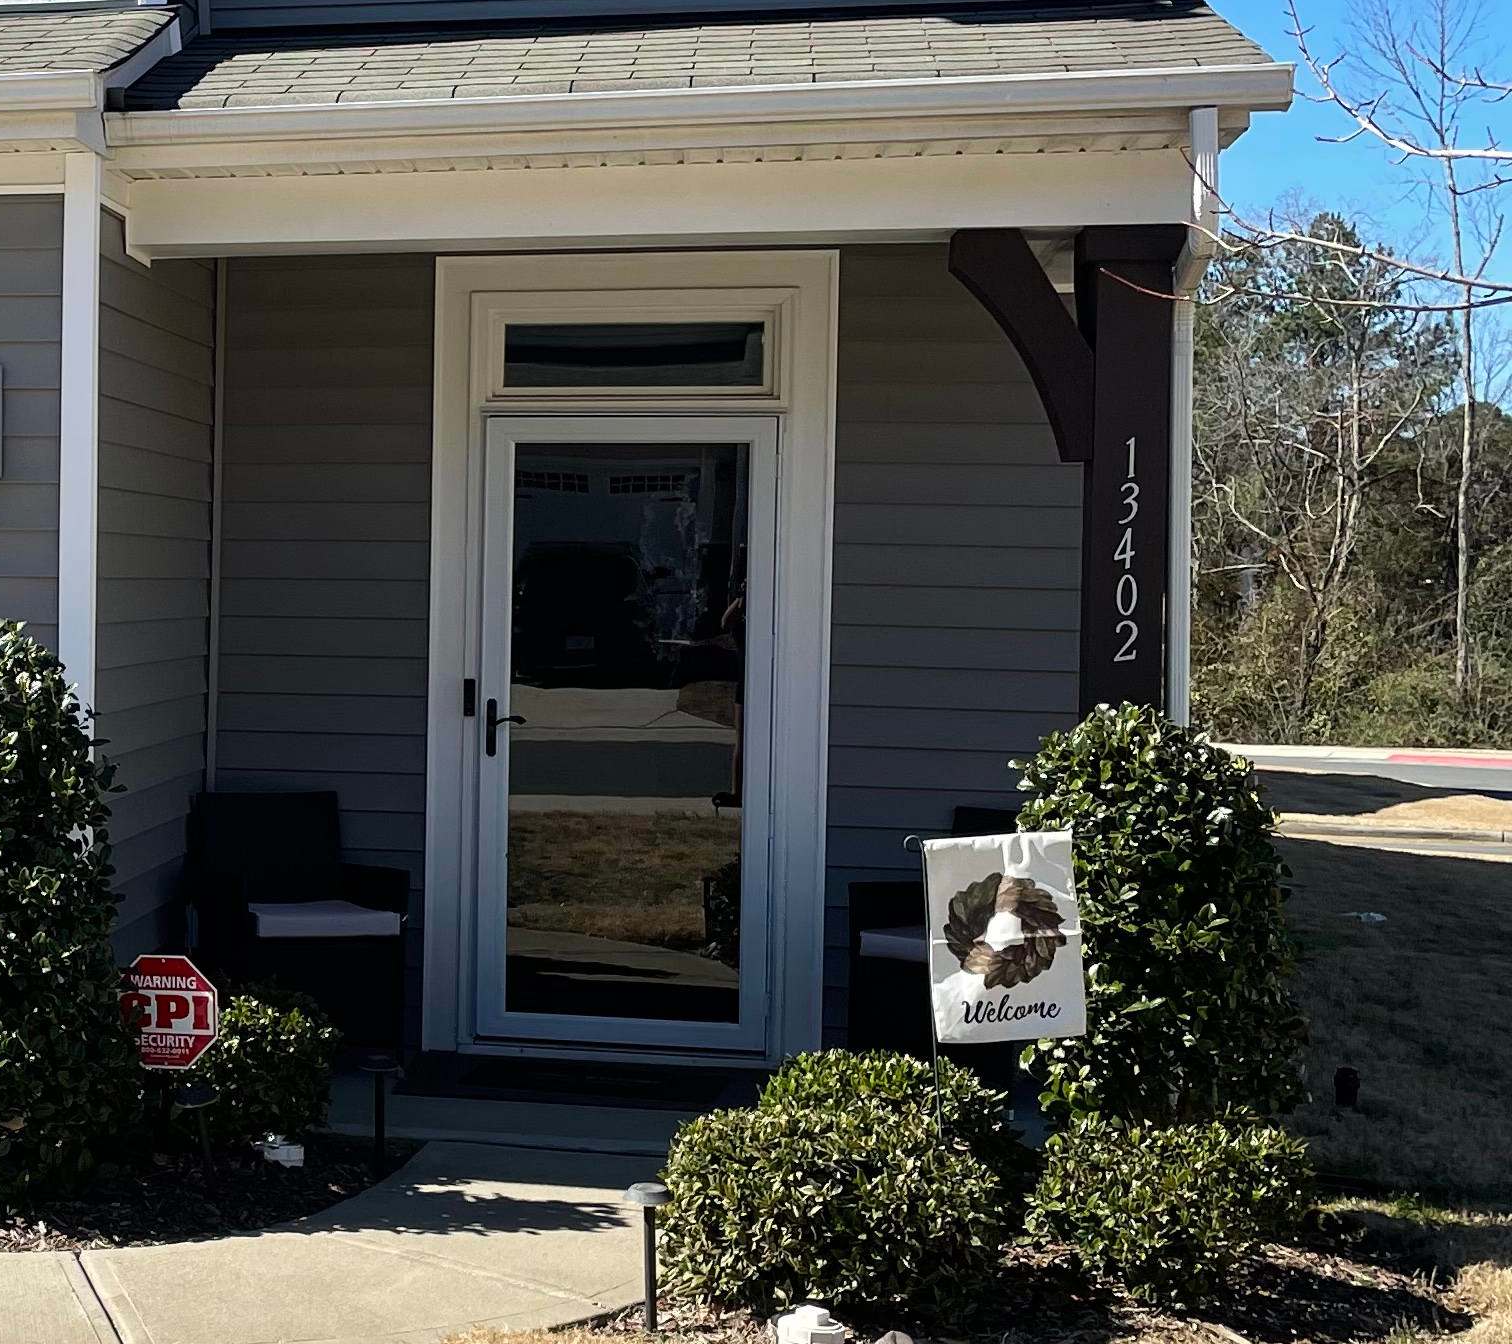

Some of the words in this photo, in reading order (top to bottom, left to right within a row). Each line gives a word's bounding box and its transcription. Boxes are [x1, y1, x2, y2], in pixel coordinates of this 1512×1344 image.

[1113, 436, 1140, 662] 13402
[131, 975, 197, 990] WARNING
[120, 993, 210, 1030] CPI
[963, 994, 1061, 1023] Welcome
[135, 1034, 195, 1048] SECURITY
